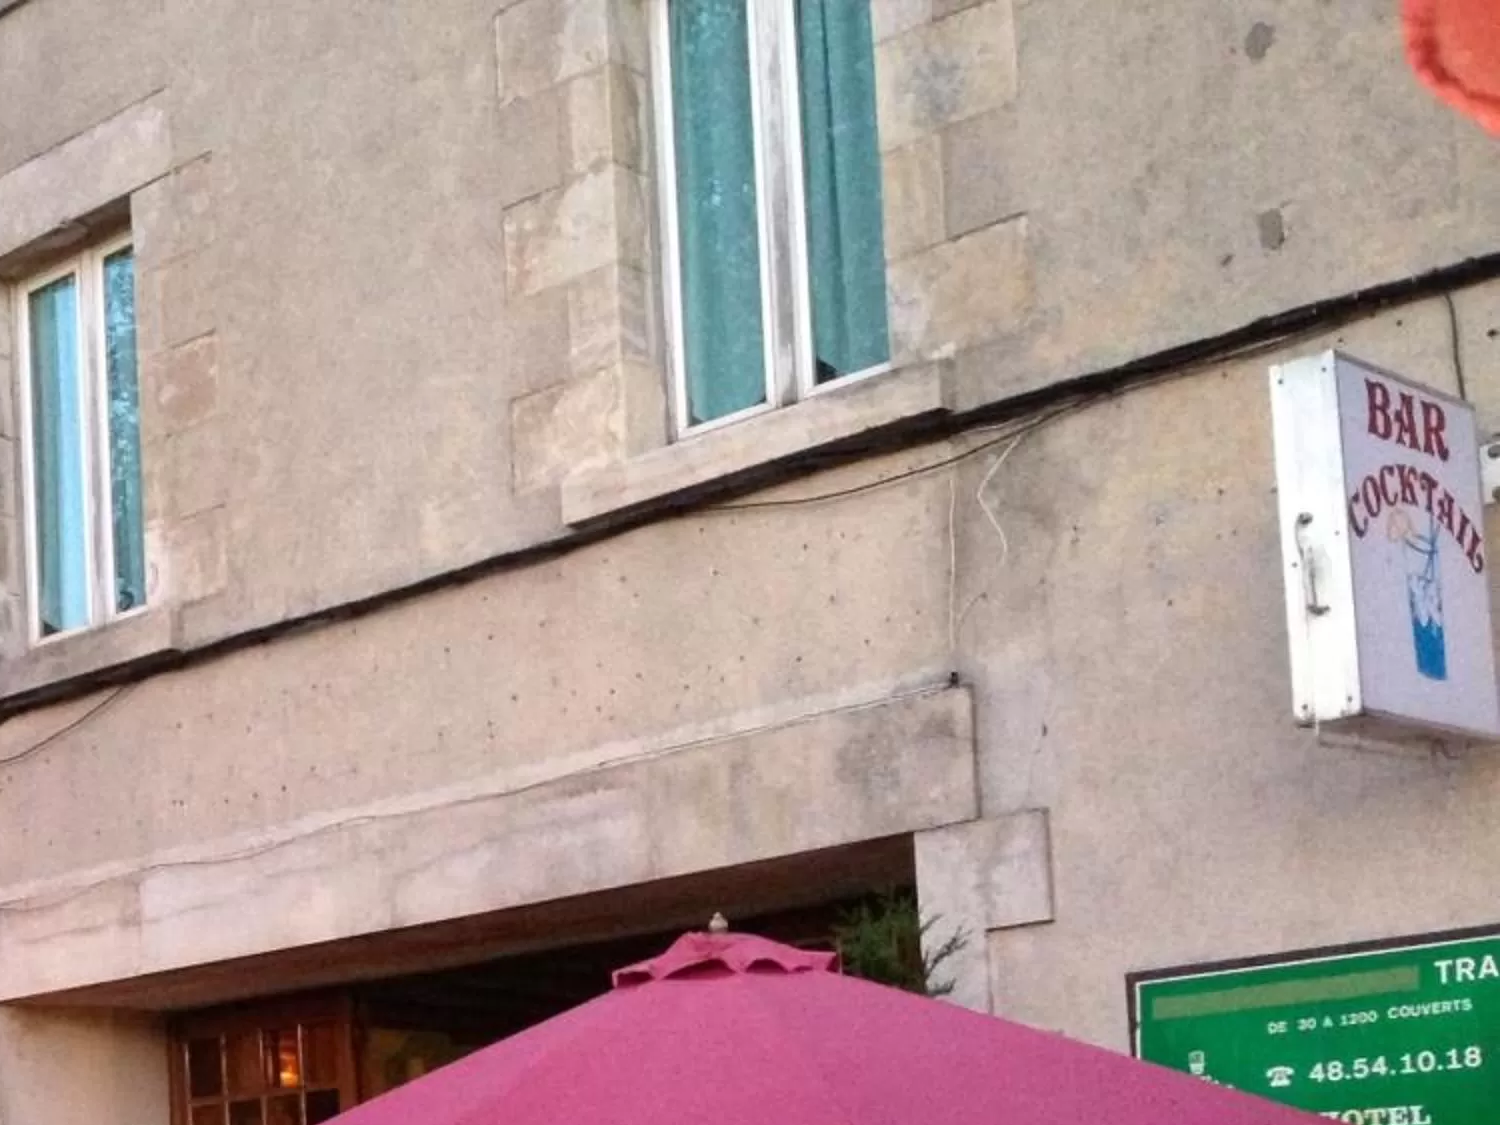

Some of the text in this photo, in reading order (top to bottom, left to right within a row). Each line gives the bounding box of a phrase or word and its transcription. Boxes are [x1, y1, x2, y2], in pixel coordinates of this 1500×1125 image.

[1363, 377, 1449, 463] BAR
[1348, 463, 1484, 574] COCKTAIL
[1433, 954, 1500, 985] TRA
[1267, 1021, 1288, 1035] DE
[1322, 1015, 1334, 1029] A
[1339, 1009, 1379, 1027] 1200
[1386, 998, 1473, 1020] COUVERTS
[1308, 1046, 1483, 1082] 48.54.10.18
